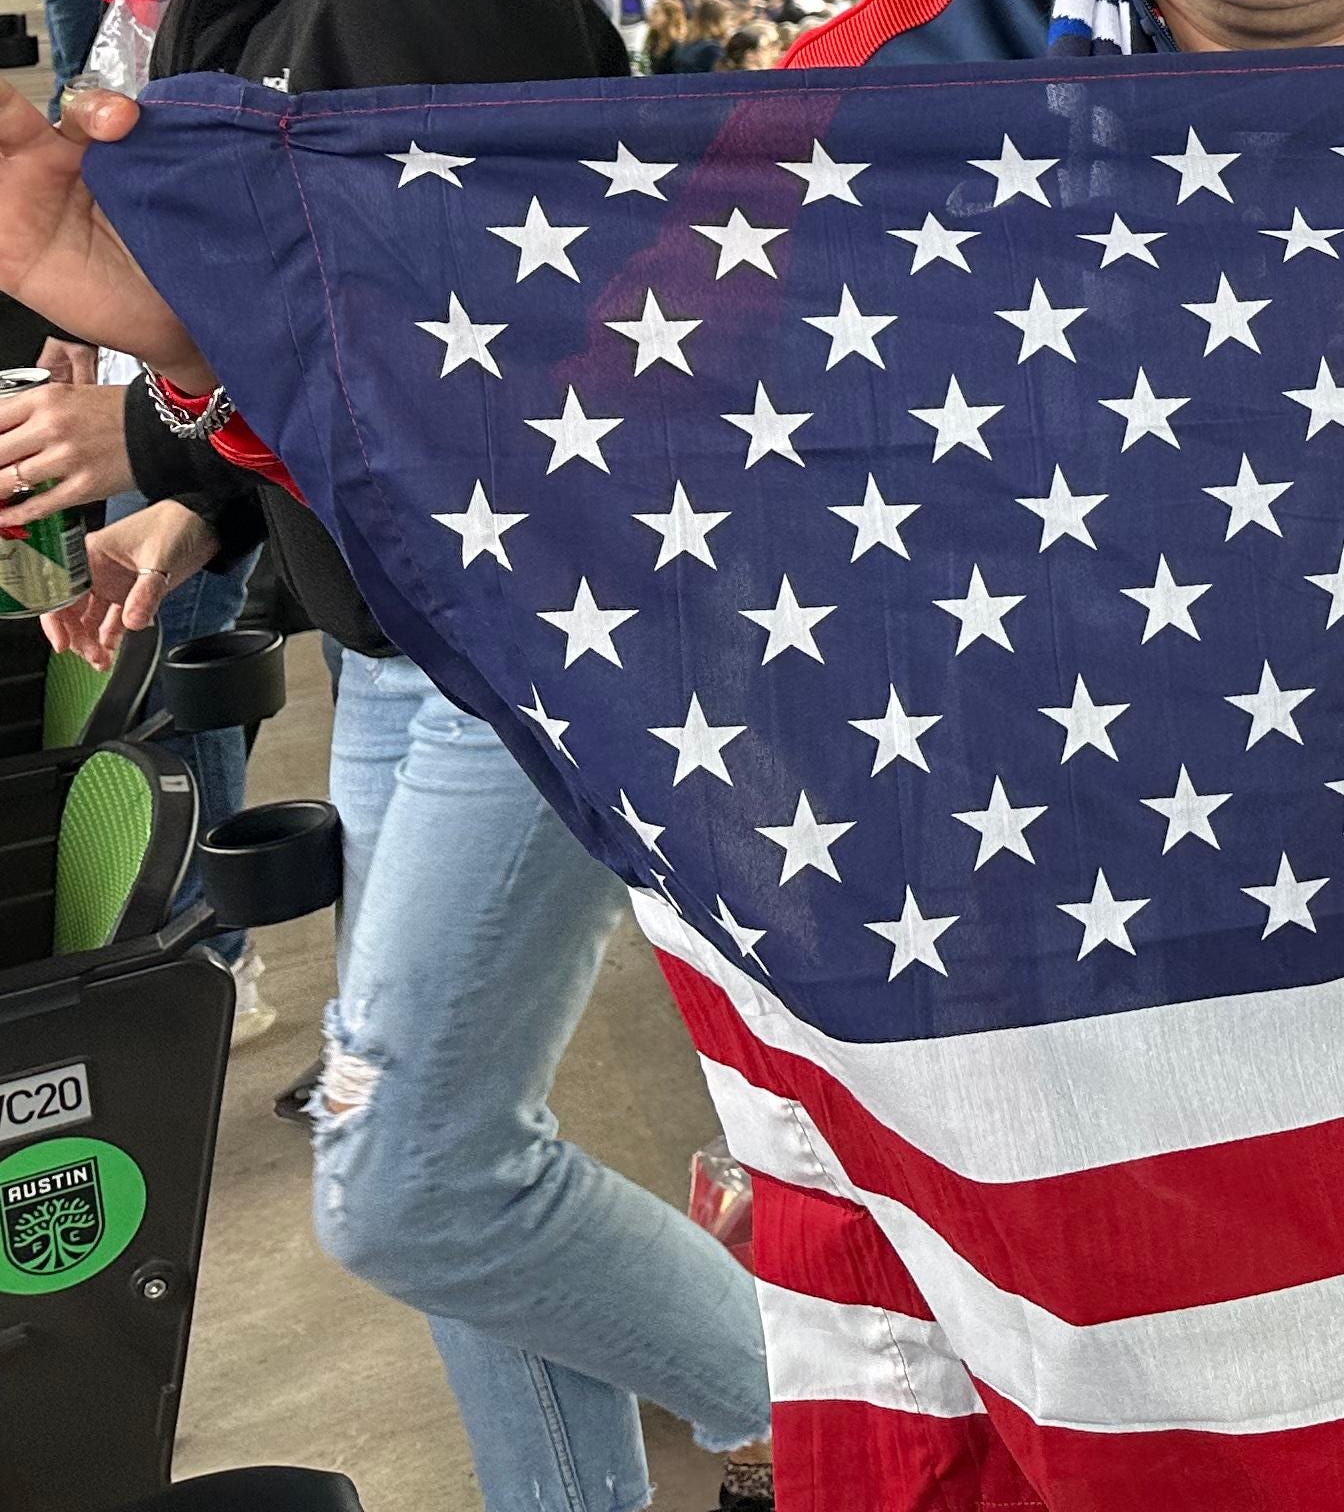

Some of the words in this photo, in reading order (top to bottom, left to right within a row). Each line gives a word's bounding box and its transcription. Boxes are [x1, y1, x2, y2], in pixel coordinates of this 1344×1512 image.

[0, 1076, 82, 1129] C20
[8, 1166, 89, 1204] AUSTIN
[32, 1241, 43, 1254] F
[69, 1229, 80, 1242] C
